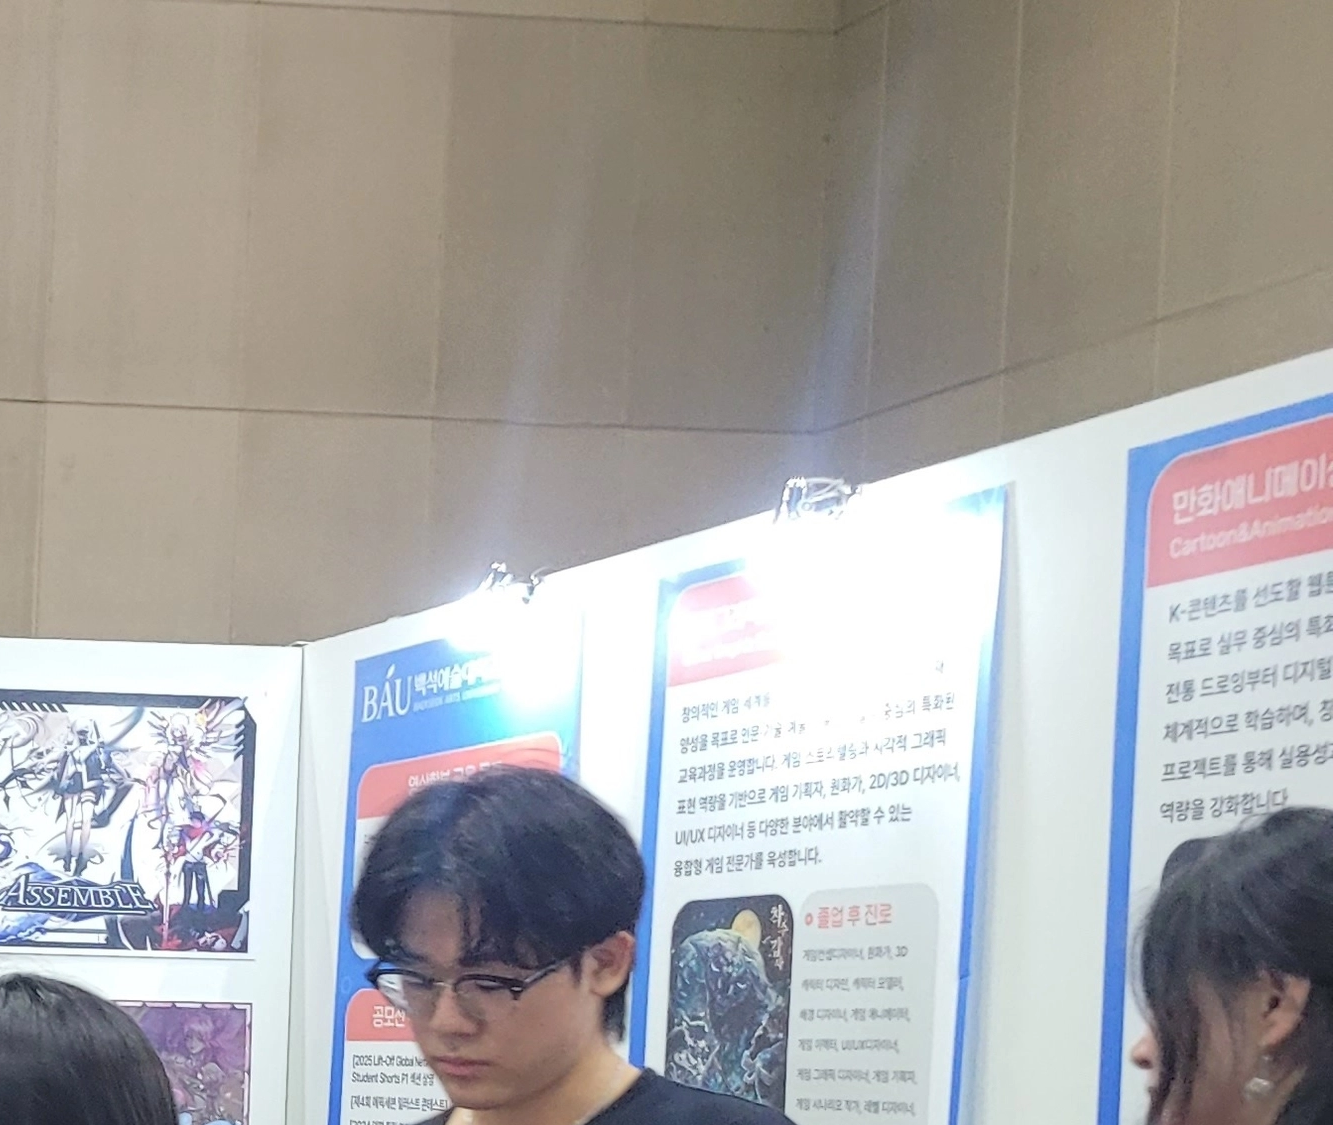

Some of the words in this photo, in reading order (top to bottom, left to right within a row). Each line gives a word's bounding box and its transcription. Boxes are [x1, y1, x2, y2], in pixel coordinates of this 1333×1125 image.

[1253, 577, 1301, 608] 선도할
[1167, 637, 1213, 663] 목표로
[1217, 629, 1248, 656] 실무
[1252, 619, 1301, 650] 중심의
[1165, 679, 1196, 704] 전통
[1200, 664, 1278, 697] 드로잉부터
[679, 733, 709, 755] 양성을
[710, 728, 739, 748] 목표로
[921, 691, 956, 713] 특화된
[680, 701, 719, 724] 창의적인
[721, 697, 740, 716] 게임
[1162, 713, 1240, 744] 체계적으로
[1244, 700, 1315, 731] 학습하며,
[677, 762, 726, 784] 교육과정을
[727, 756, 778, 779] 운영합니다.
[781, 750, 802, 769] 게임
[910, 727, 947, 749] 그래픽
[1161, 753, 1238, 782] 프로젝트를
[1241, 748, 1275, 774] 통해
[676, 796, 697, 815] 표현
[698, 791, 726, 812] 역량을
[728, 786, 767, 810] 기반으로
[768, 784, 789, 803] 게임
[792, 779, 827, 800] 기획자,
[830, 774, 866, 797] 원화가,
[868, 770, 910, 792] 2D/3D
[912, 762, 961, 786] 디자이너,
[674, 828, 706, 847] UI/UX
[707, 820, 744, 843] 디자이너
[746, 820, 756, 839] 등
[758, 817, 789, 837] 다양한
[791, 811, 835, 834] 분야에서
[837, 806, 871, 829] 활약할
[873, 806, 886, 824] 수
[888, 803, 913, 823] 있는
[1159, 798, 1206, 824] 역량을
[673, 857, 703, 878] 융합형
[704, 855, 724, 876] 게임
[725, 850, 764, 873] 전문가를
[766, 846, 823, 869] 육성합니다.
[816, 905, 845, 930] 졸업
[847, 904, 861, 928] 후
[864, 902, 893, 926] 진로
[895, 945, 909, 958] 3D
[351, 1072, 379, 1084] Student
[379, 1072, 401, 1085] Shorts
